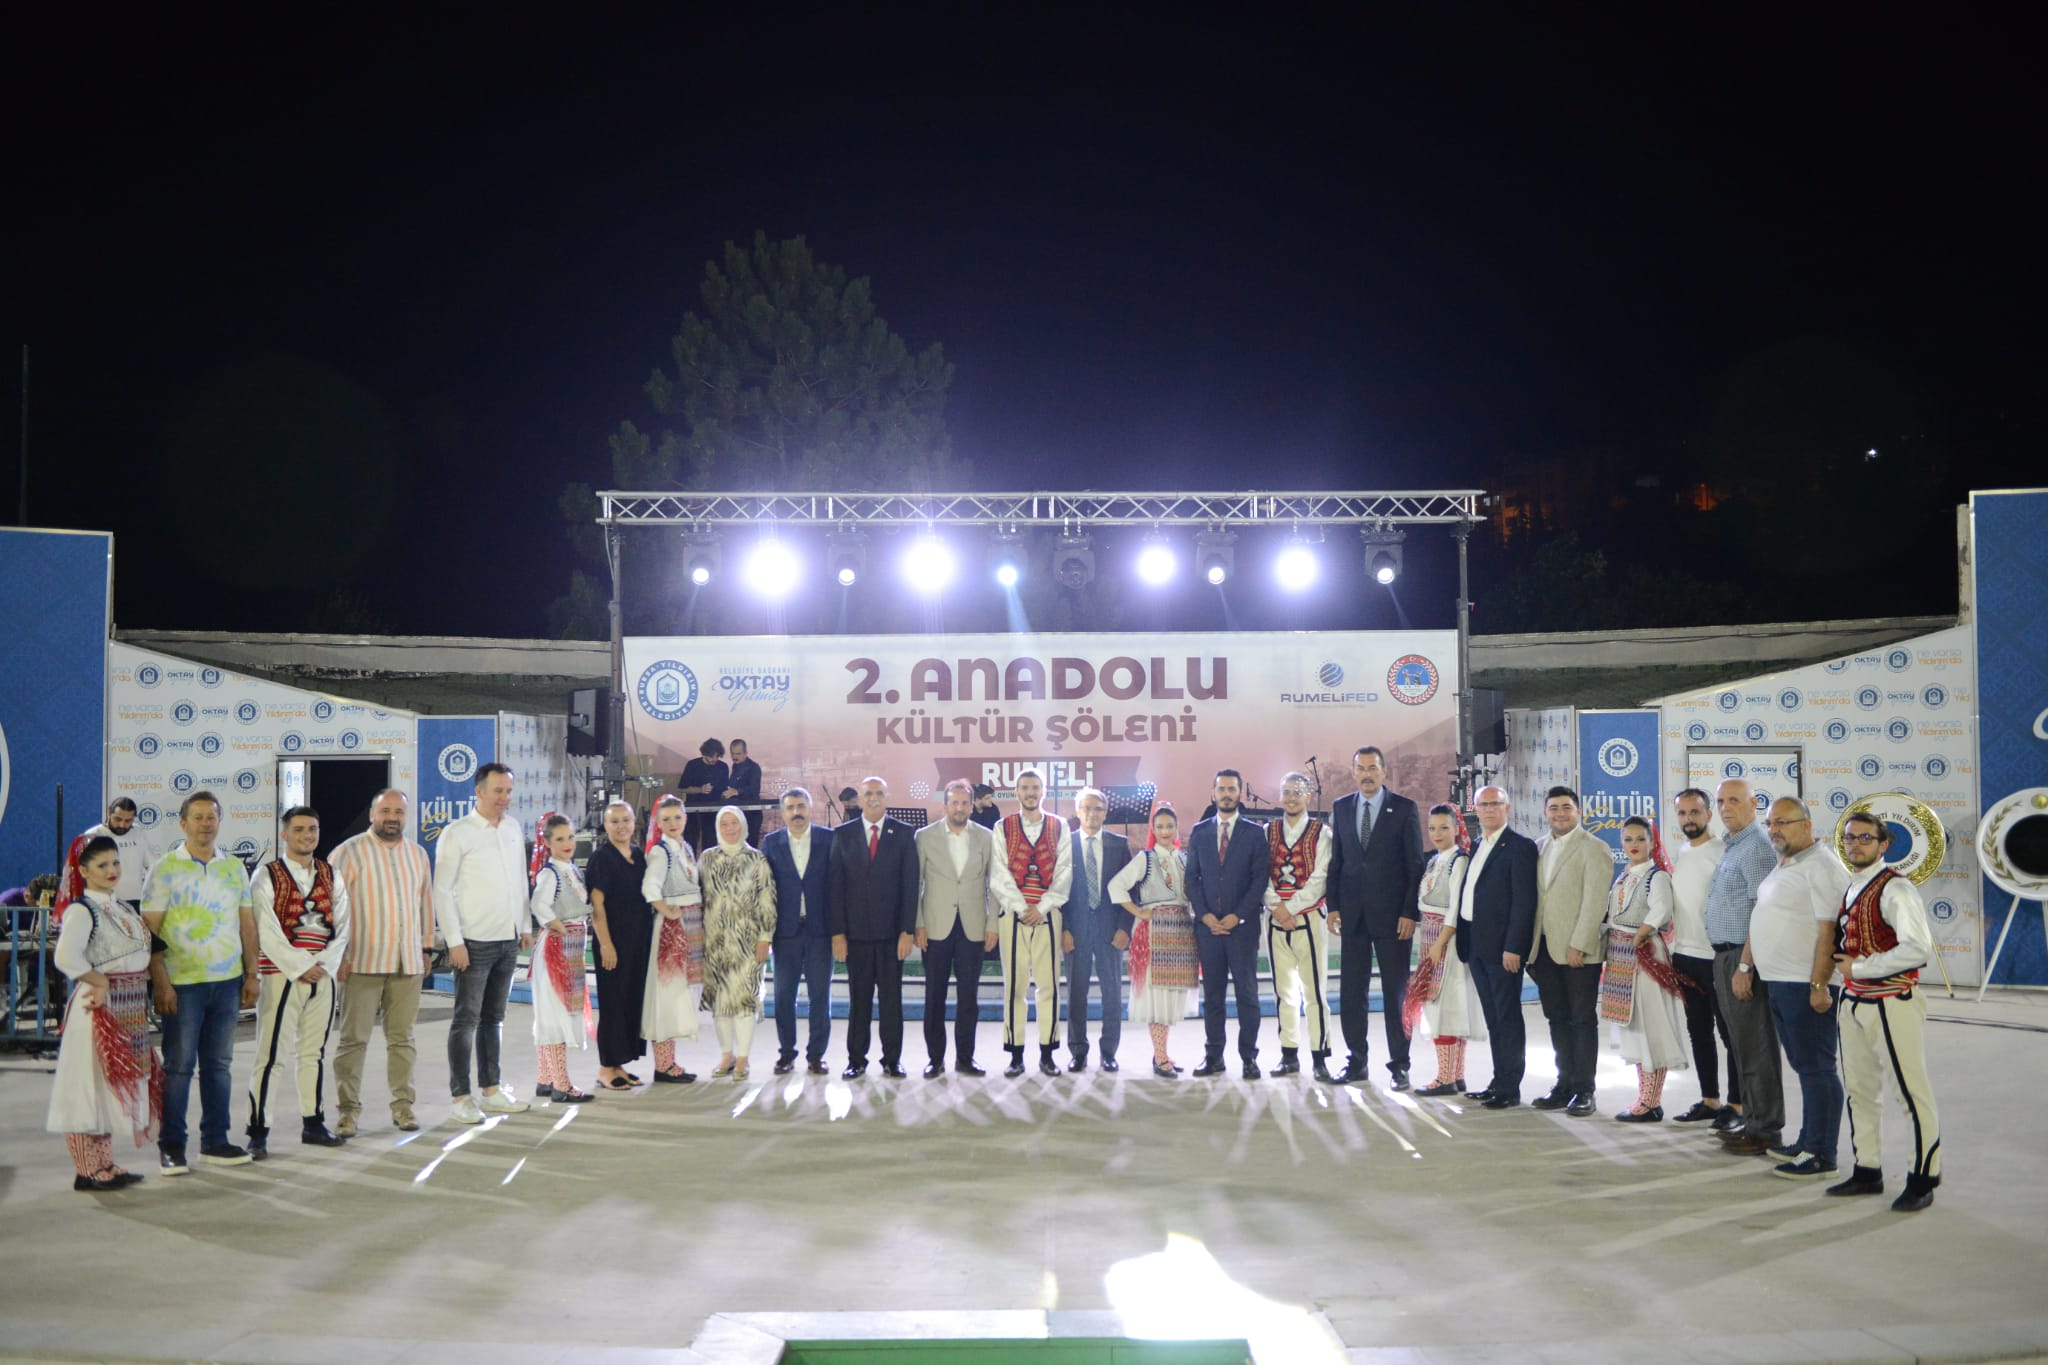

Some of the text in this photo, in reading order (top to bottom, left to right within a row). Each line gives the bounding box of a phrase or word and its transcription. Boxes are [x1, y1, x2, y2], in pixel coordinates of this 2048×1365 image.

[167, 671, 194, 679] OKTAY
[720, 675, 790, 691] OKTAY
[1745, 696, 1772, 704] OKTAY
[1887, 692, 1914, 700] OKTAY
[202, 708, 229, 716] OKTAY
[877, 705, 1197, 751] KÜLTÜR ŞÖLENİ
[1713, 728, 1739, 736] OKTAY
[1854, 726, 1882, 734] OKTAY
[167, 741, 194, 749] OKTAY
[309, 738, 335, 746] OKTAY
[1751, 766, 1778, 774] OKTAY
[1888, 762, 1917, 771] OKTAY
[201, 778, 228, 786] OKTAY
[1582, 790, 1656, 818] KÜLTÜR
[421, 796, 477, 824] KÜLTÜ
[1892, 811, 1921, 838] YILDIRIM
[1894, 851, 1920, 871] KANLIĞI
